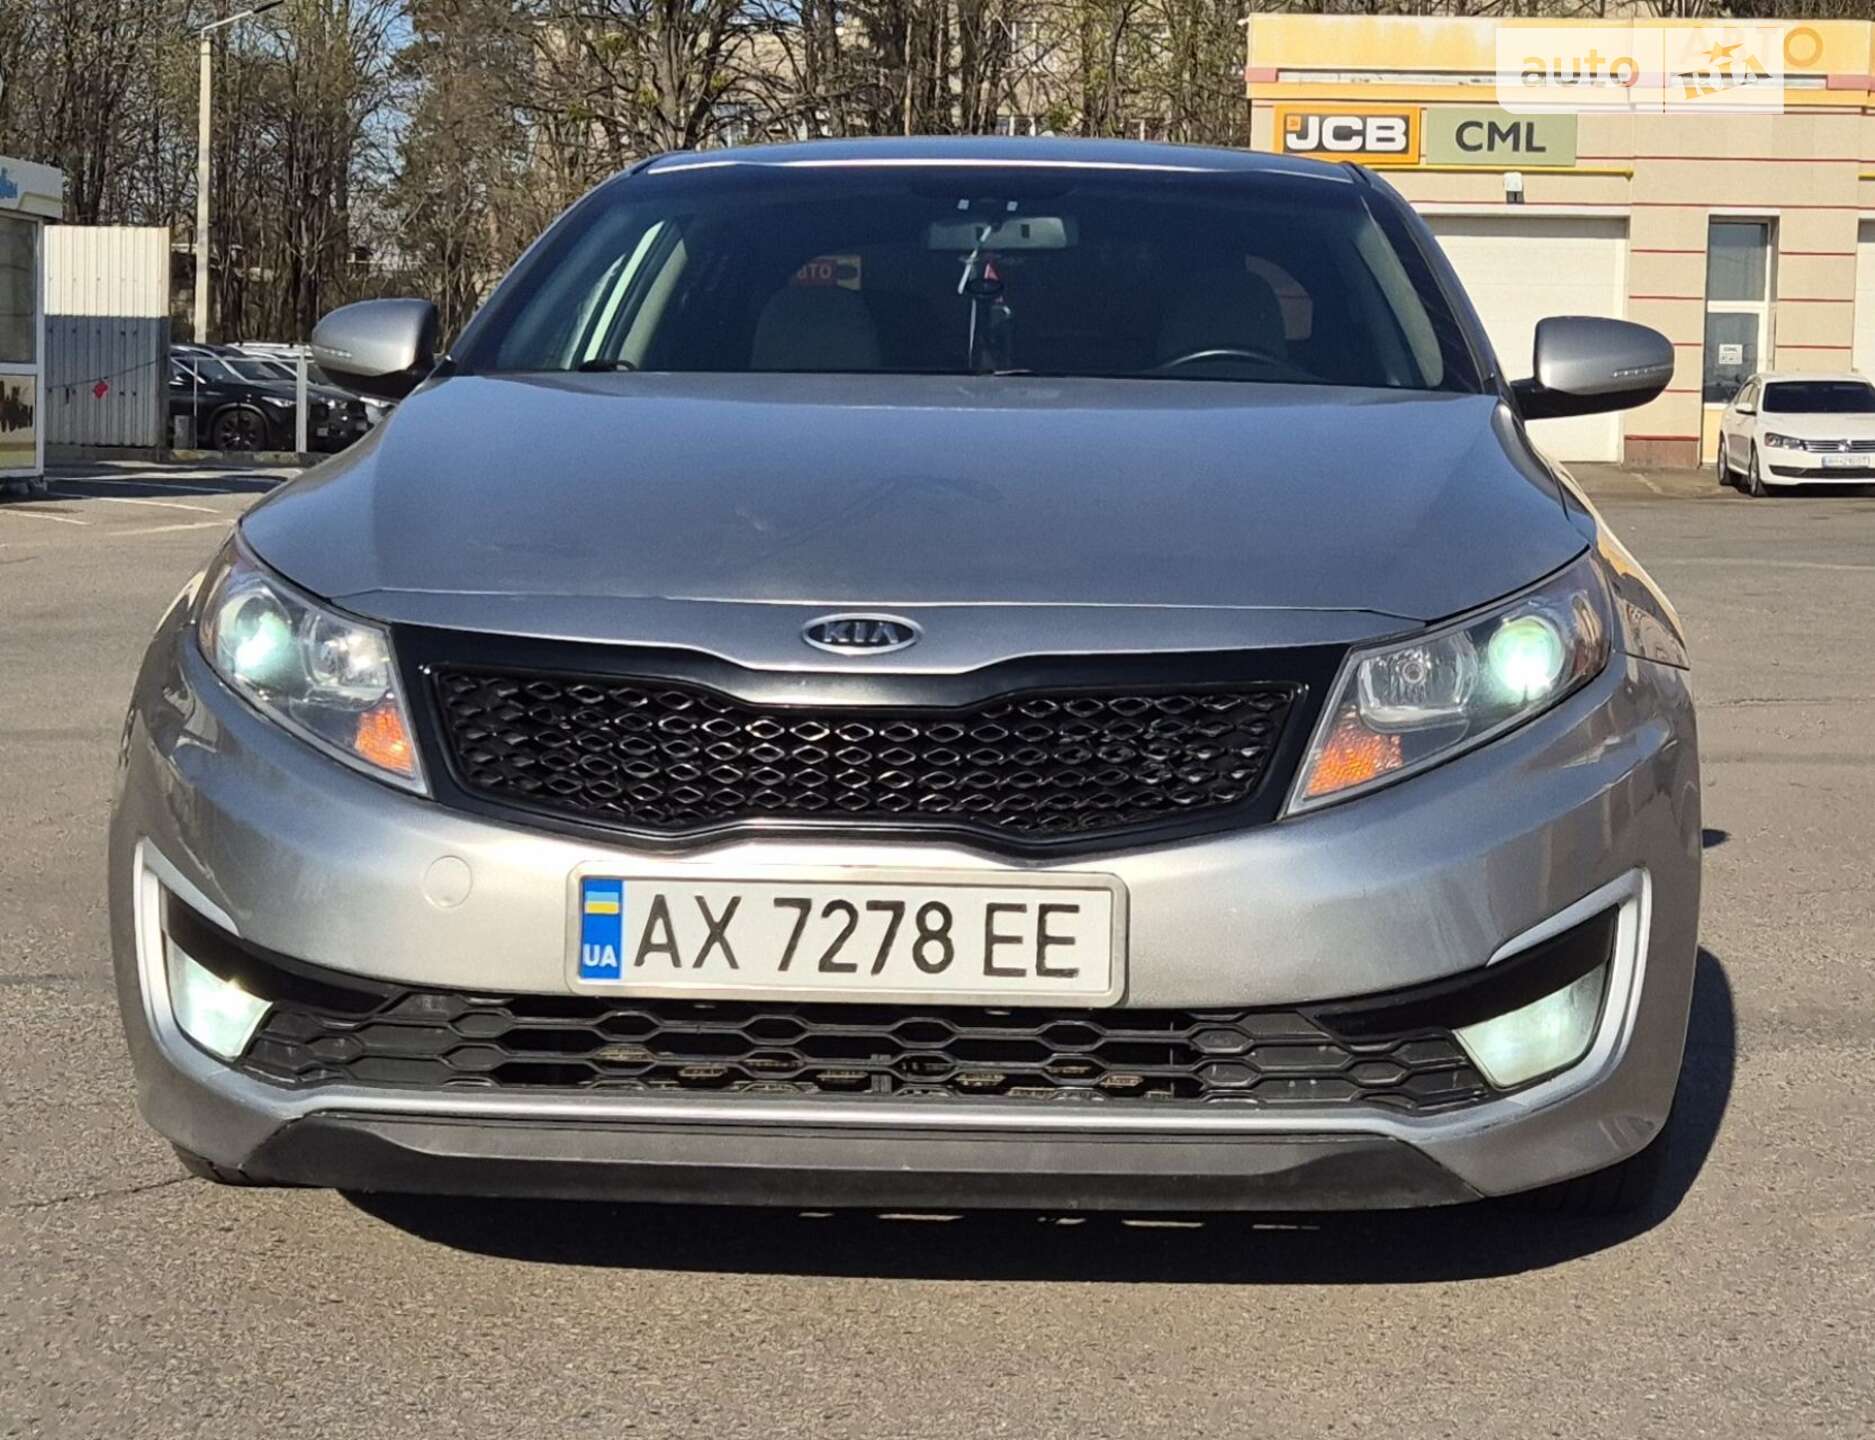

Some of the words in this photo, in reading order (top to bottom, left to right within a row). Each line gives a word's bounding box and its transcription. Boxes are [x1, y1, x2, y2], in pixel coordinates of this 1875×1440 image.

[1286, 115, 1407, 151] JCB
[1455, 121, 1546, 152] CML
[823, 621, 899, 643] KIA
[633, 894, 741, 969] AX
[773, 898, 955, 975] 7278
[983, 902, 1080, 978] EE
[583, 943, 618, 968] UA
